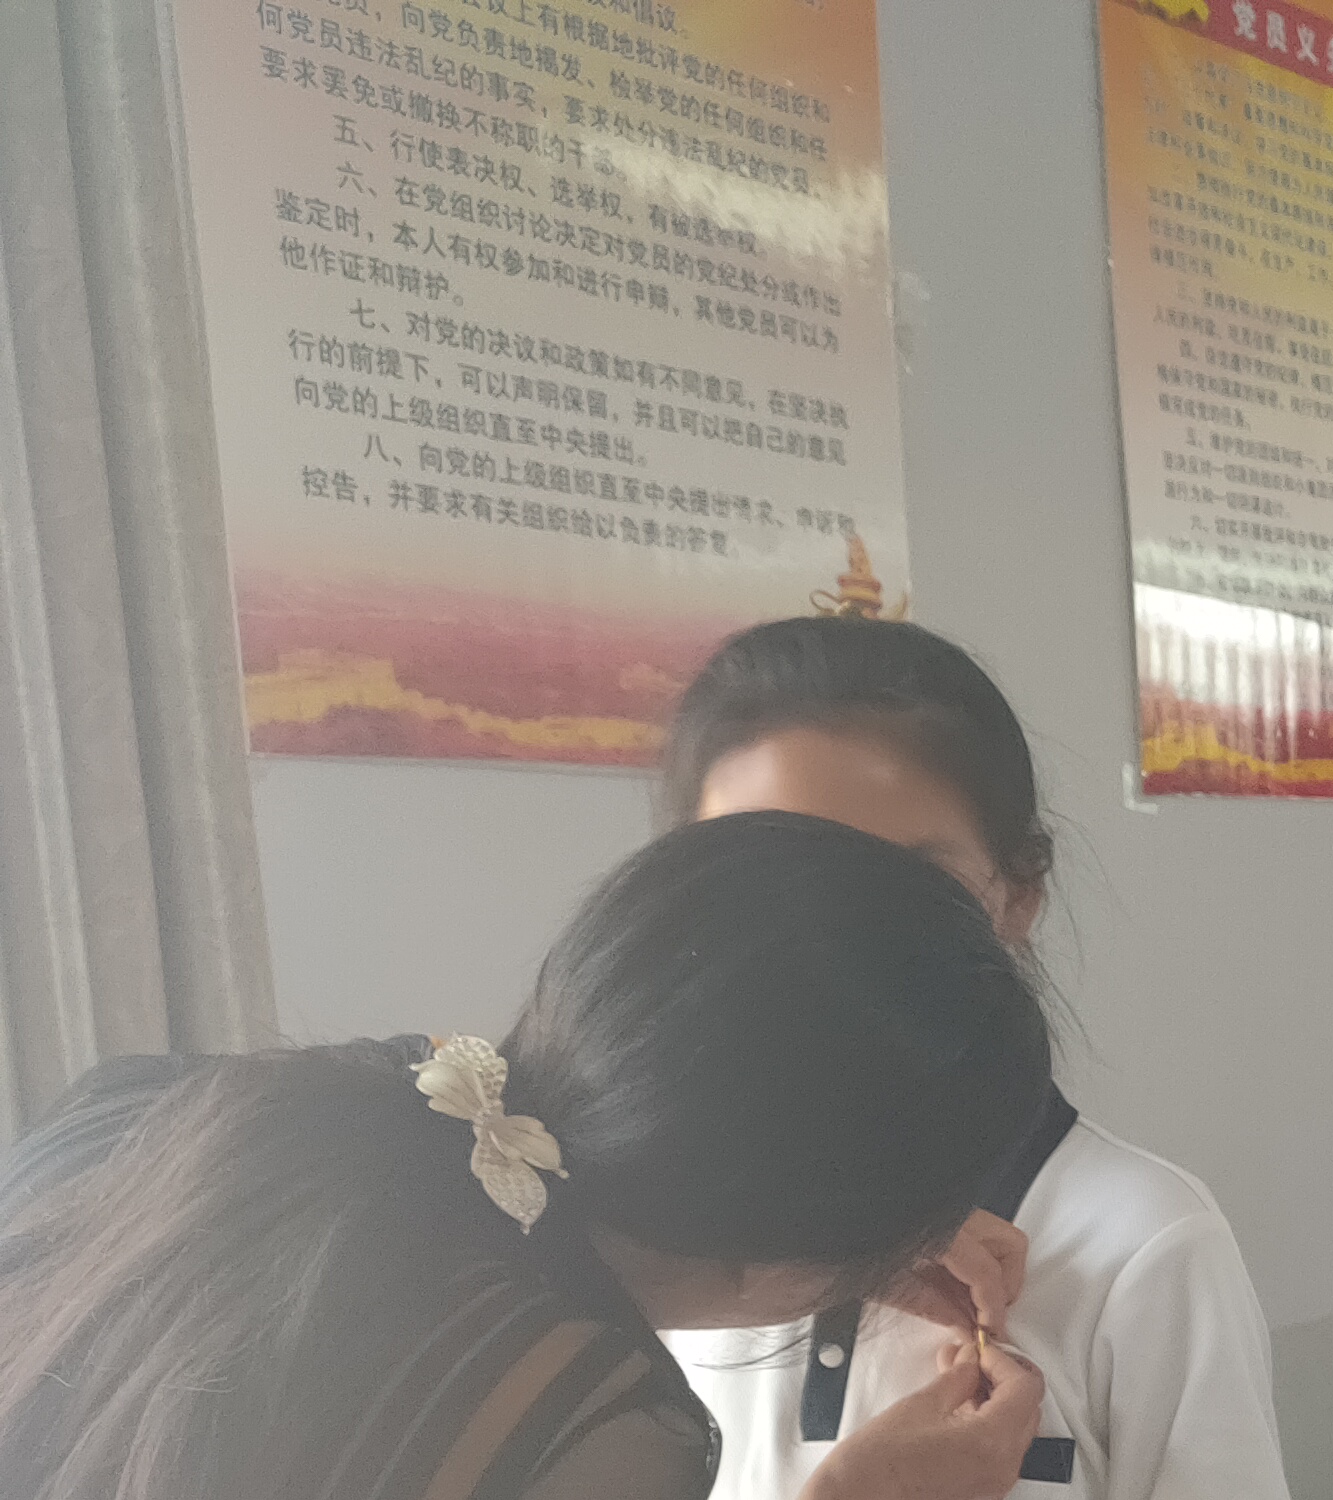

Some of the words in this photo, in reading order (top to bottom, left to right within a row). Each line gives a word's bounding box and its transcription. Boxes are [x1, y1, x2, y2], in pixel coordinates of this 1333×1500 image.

[294, 375, 648, 468] 向党的上级组织直至中央提出。
